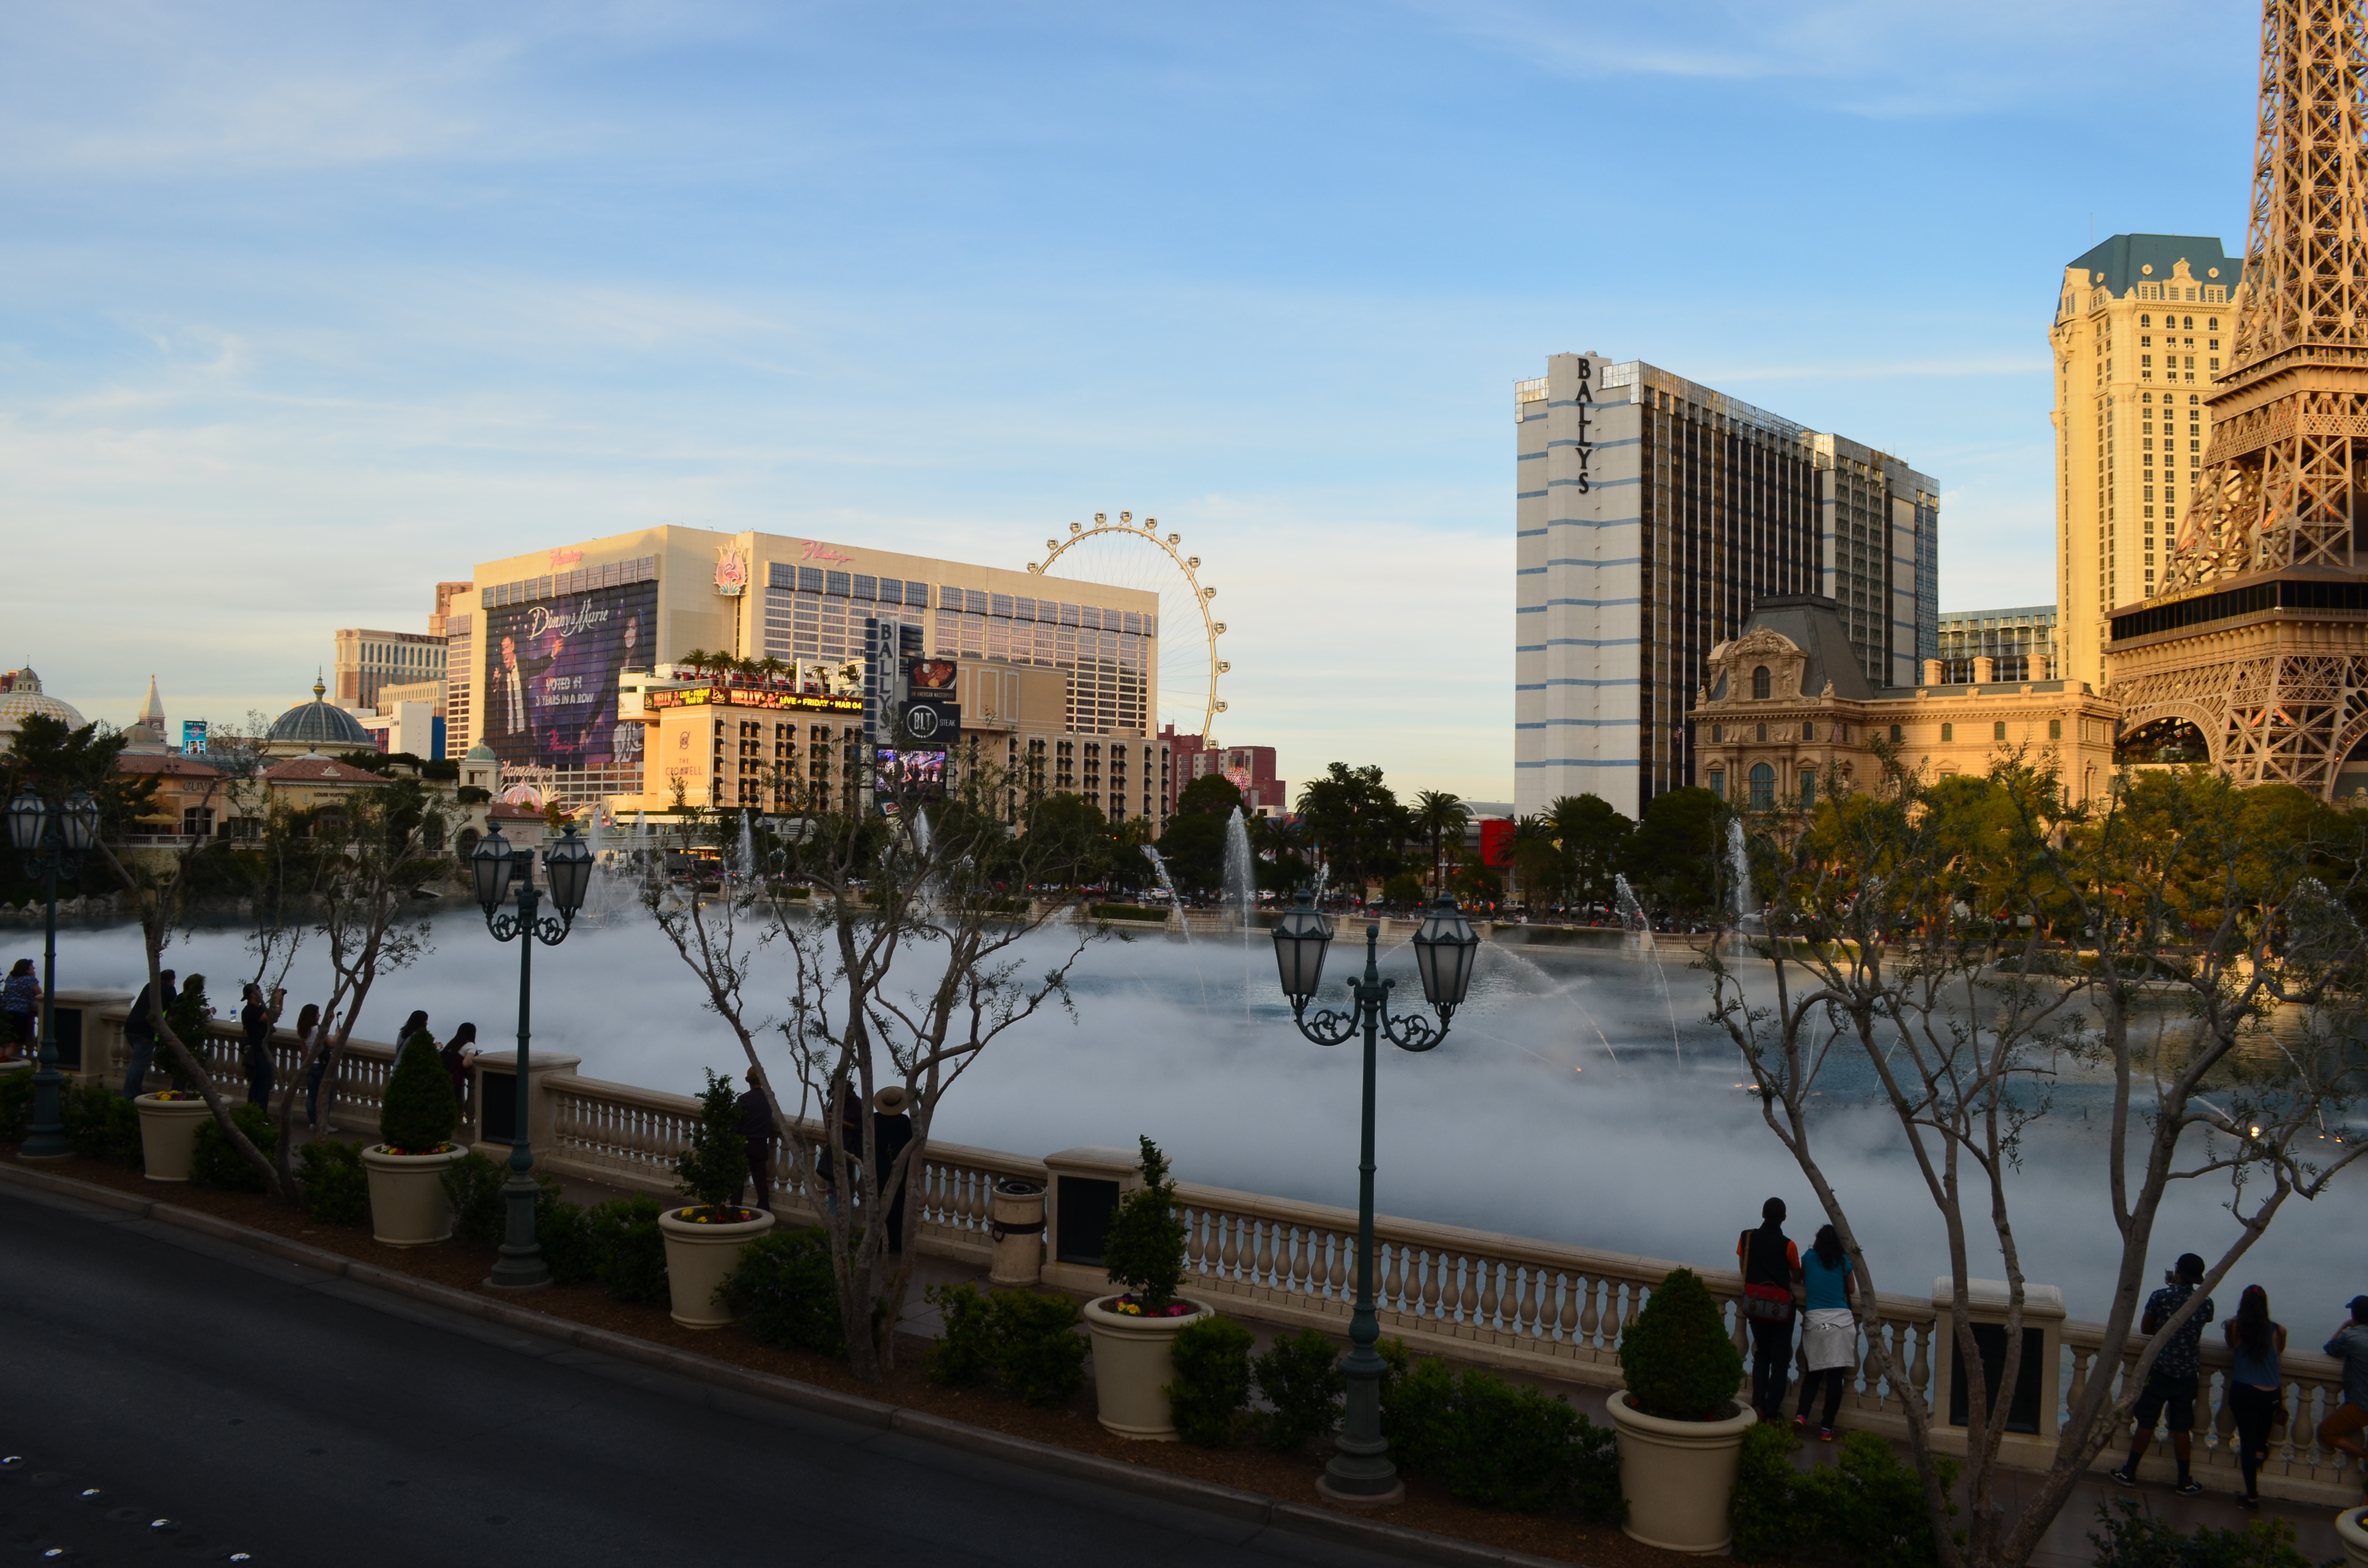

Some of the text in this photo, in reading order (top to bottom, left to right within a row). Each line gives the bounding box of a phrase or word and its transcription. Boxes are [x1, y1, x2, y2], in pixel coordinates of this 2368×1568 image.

[1575, 358, 1592, 494] BALLYS
[549, 549, 585, 570] Flamingo
[800, 539, 855, 566] Flamingo
[527, 606, 571, 640] Donny
[568, 598, 608, 634] Marie
[546, 676, 582, 691] VOTED #1
[535, 692, 594, 706] 3 YEARS IN A ROW
[654, 691, 672, 706] NELLY
[693, 688, 710, 697] FRIDAY
[731, 690, 760, 705] NELLY
[803, 698, 828, 707] FRIDAY
[914, 712, 932, 730] BLT
[546, 729, 578, 755] Flamingo
[665, 766, 702, 776] CROMWELL
